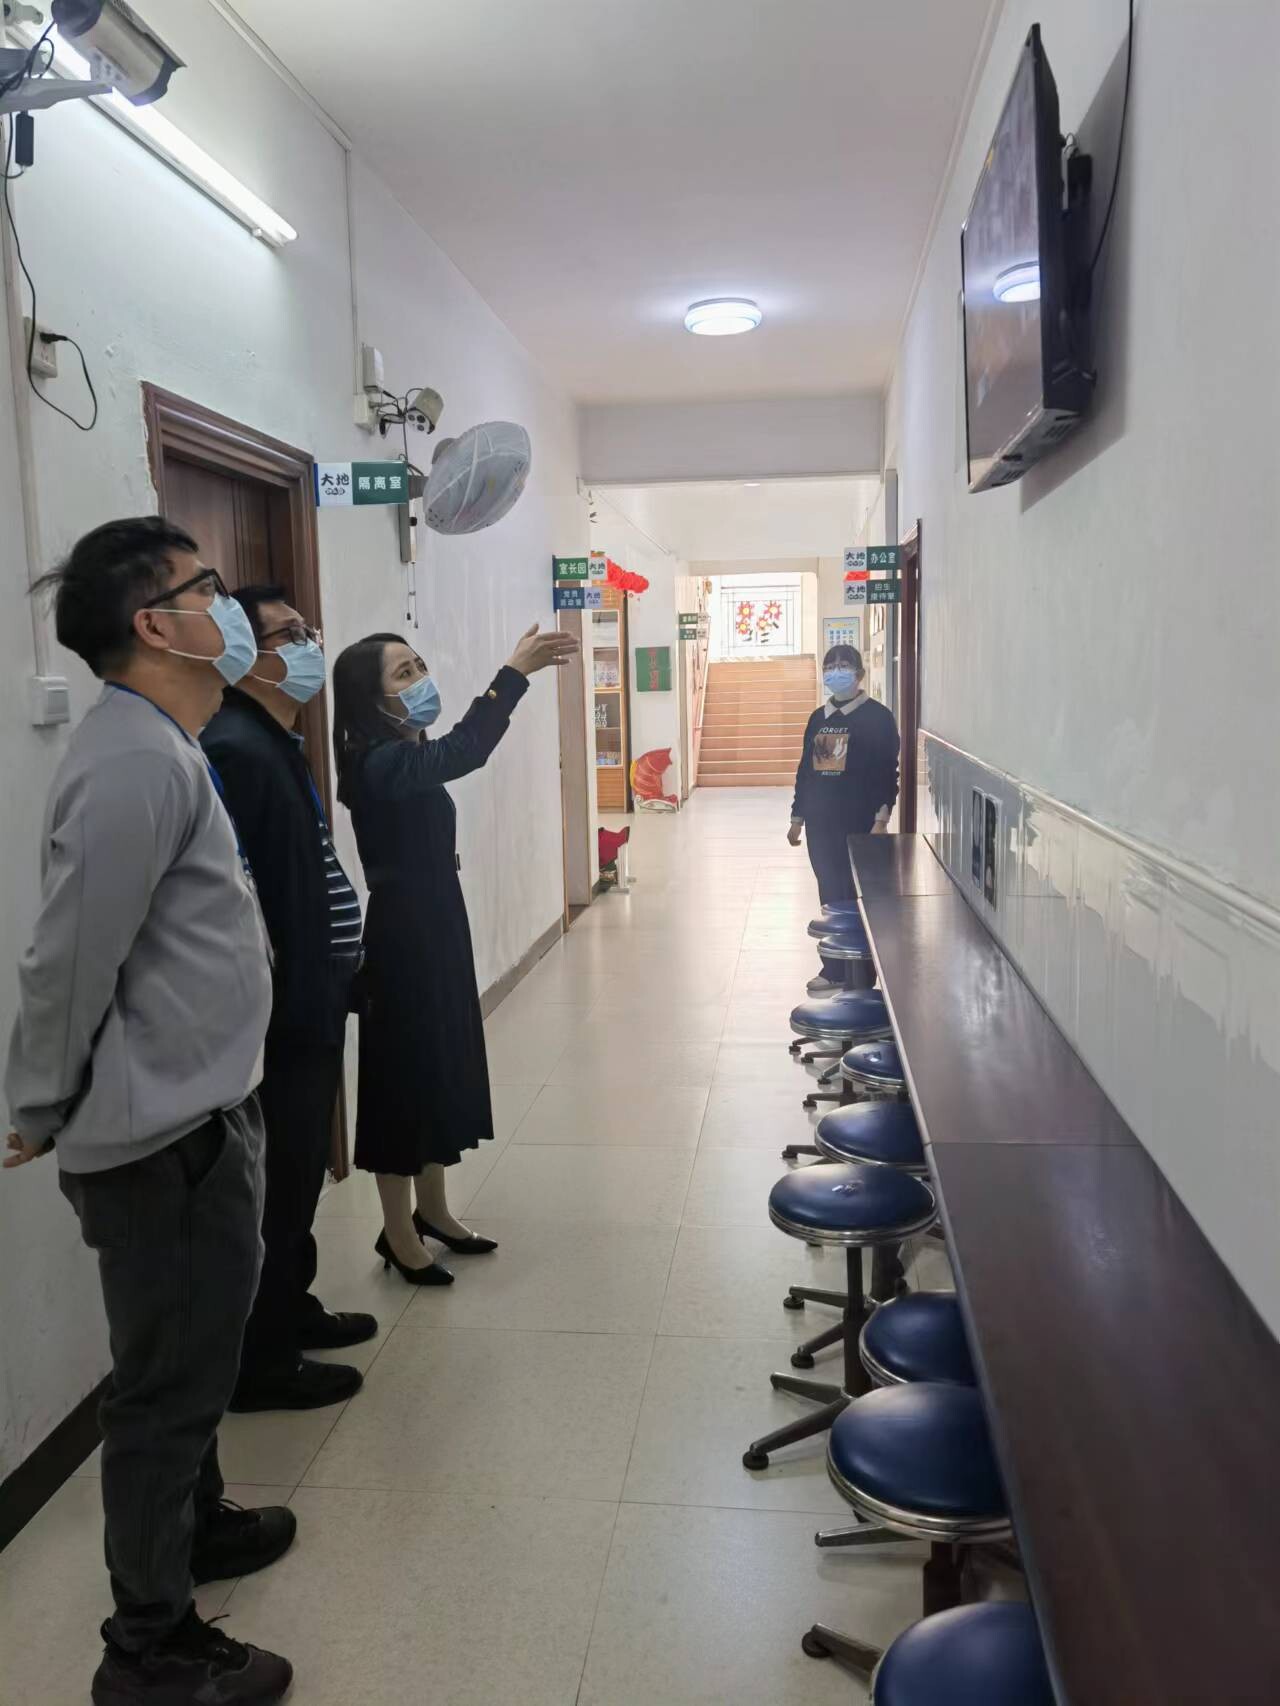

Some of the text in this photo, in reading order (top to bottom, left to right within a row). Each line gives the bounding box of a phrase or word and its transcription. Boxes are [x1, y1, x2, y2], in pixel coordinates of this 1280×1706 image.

[321, 473, 349, 486] 大地
[358, 476, 402, 490] 隔离室
[846, 551, 865, 560] 大地
[870, 552, 896, 564] 办公室
[846, 585, 865, 594] 大地
